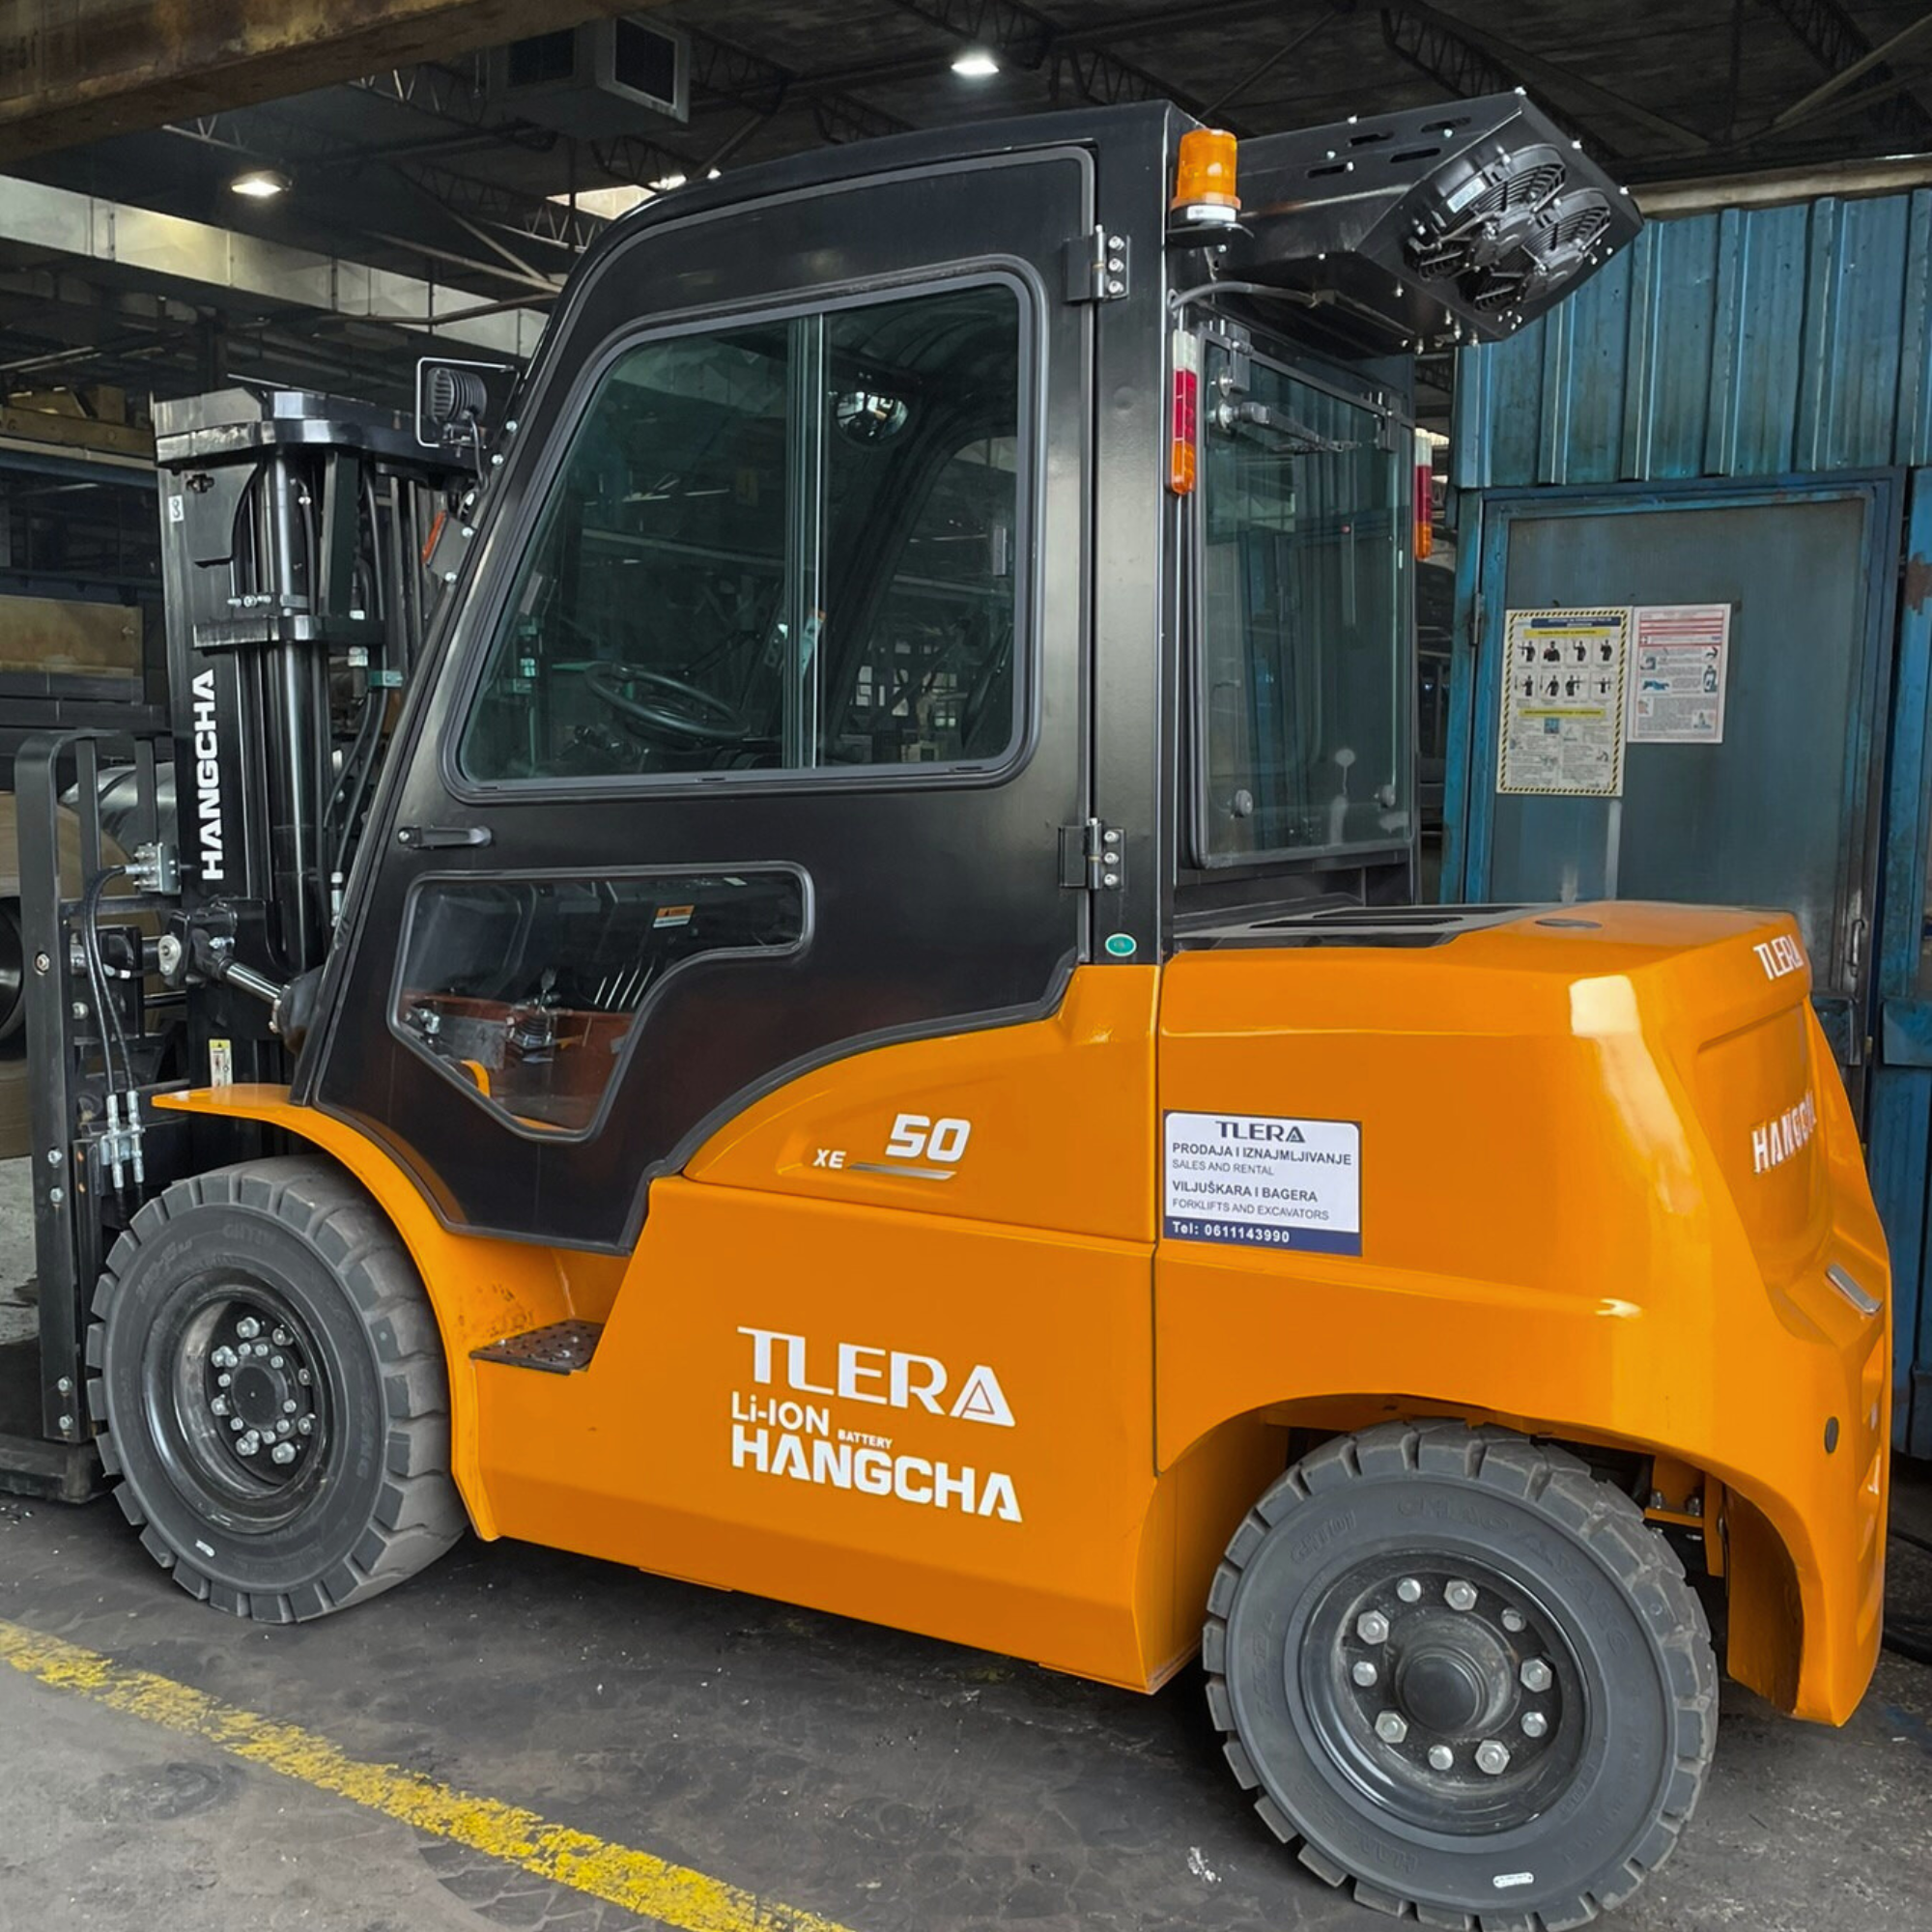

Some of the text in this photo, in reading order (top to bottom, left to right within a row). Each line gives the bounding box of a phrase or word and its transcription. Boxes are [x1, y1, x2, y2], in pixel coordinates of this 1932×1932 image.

[192, 668, 224, 880] HANGCHA
[885, 1113, 971, 1162] 50
[1215, 1121, 1306, 1143] TLERA
[812, 1149, 846, 1169] XE
[1172, 1142, 1351, 1165] PRODAJA I IZNAJMLJIVANJE
[1172, 1158, 1274, 1176] SALES AND RENTAL
[1172, 1179, 1318, 1203] VILJUŠKARA I BAGERA
[1172, 1198, 1329, 1221] FORKLIFTS AND EXCAVATORS
[1172, 1221, 1291, 1243] Tel: 0611143990
[737, 1326, 1015, 1428] TLERA
[731, 1391, 830, 1437] Li-ION
[838, 1429, 893, 1449] BATTERY
[732, 1424, 1023, 1523] HANGCHA
